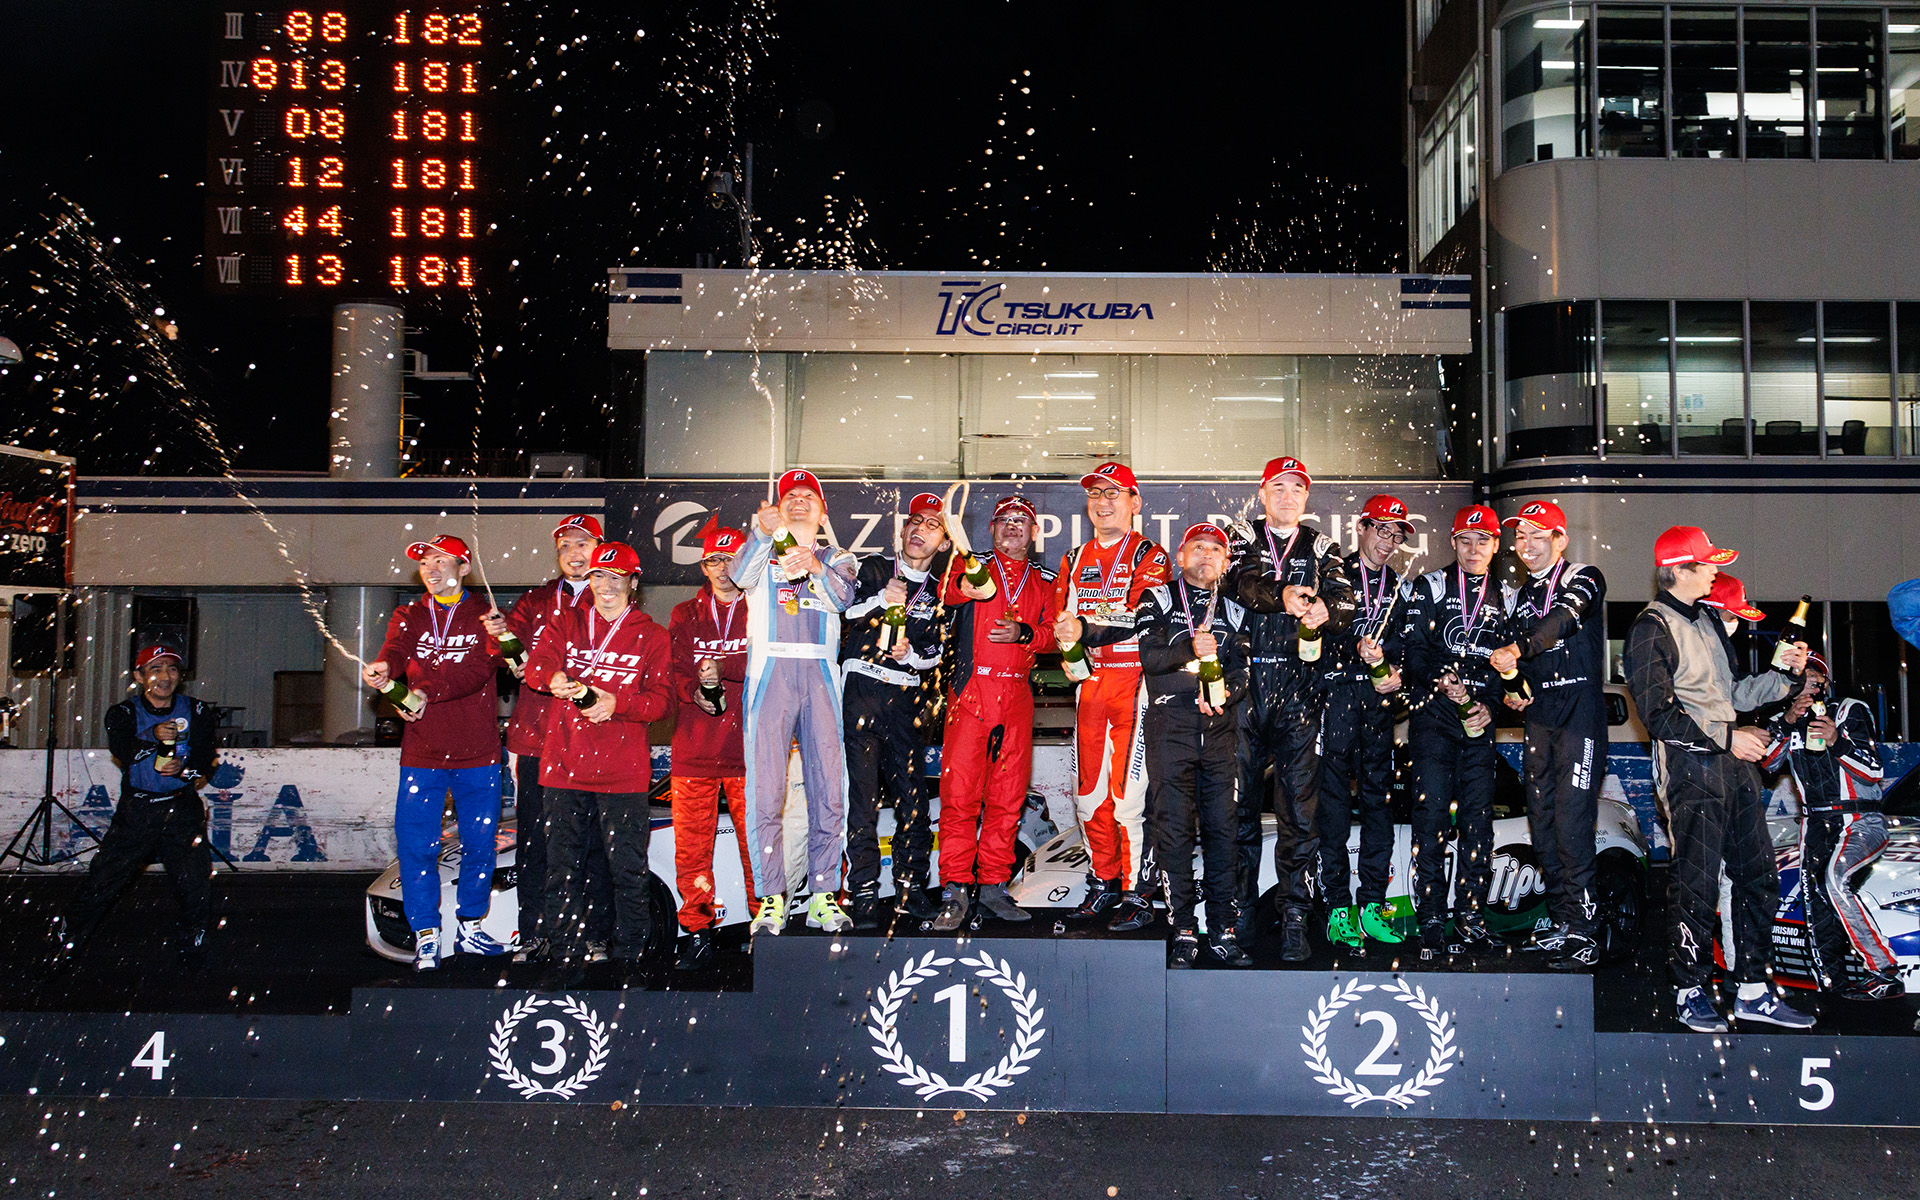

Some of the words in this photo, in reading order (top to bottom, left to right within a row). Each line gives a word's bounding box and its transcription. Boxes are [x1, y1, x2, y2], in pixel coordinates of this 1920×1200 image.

[287, 11, 347, 42] 88
[394, 13, 482, 46] 182
[252, 58, 346, 90] 813
[394, 61, 477, 93] 181
[285, 108, 345, 139] 08
[393, 110, 476, 141] 181
[288, 157, 344, 188] 12
[391, 159, 475, 190] 181
[284, 205, 342, 236] 44
[390, 207, 474, 238] 181
[286, 254, 342, 285] 13
[389, 256, 474, 287] 181
[1004, 302, 1154, 319] TSUKUBA
[11, 533, 47, 550] zero
[1581, 737, 1592, 773] TURISMO
[1772, 925, 1799, 936] URISMO
[1772, 935, 1788, 945] URAI
[933, 983, 967, 1063] 1
[131, 1031, 170, 1080] 4
[530, 1019, 567, 1075] 3
[1354, 1010, 1403, 1077] 2
[1799, 1057, 1835, 1111] 5
